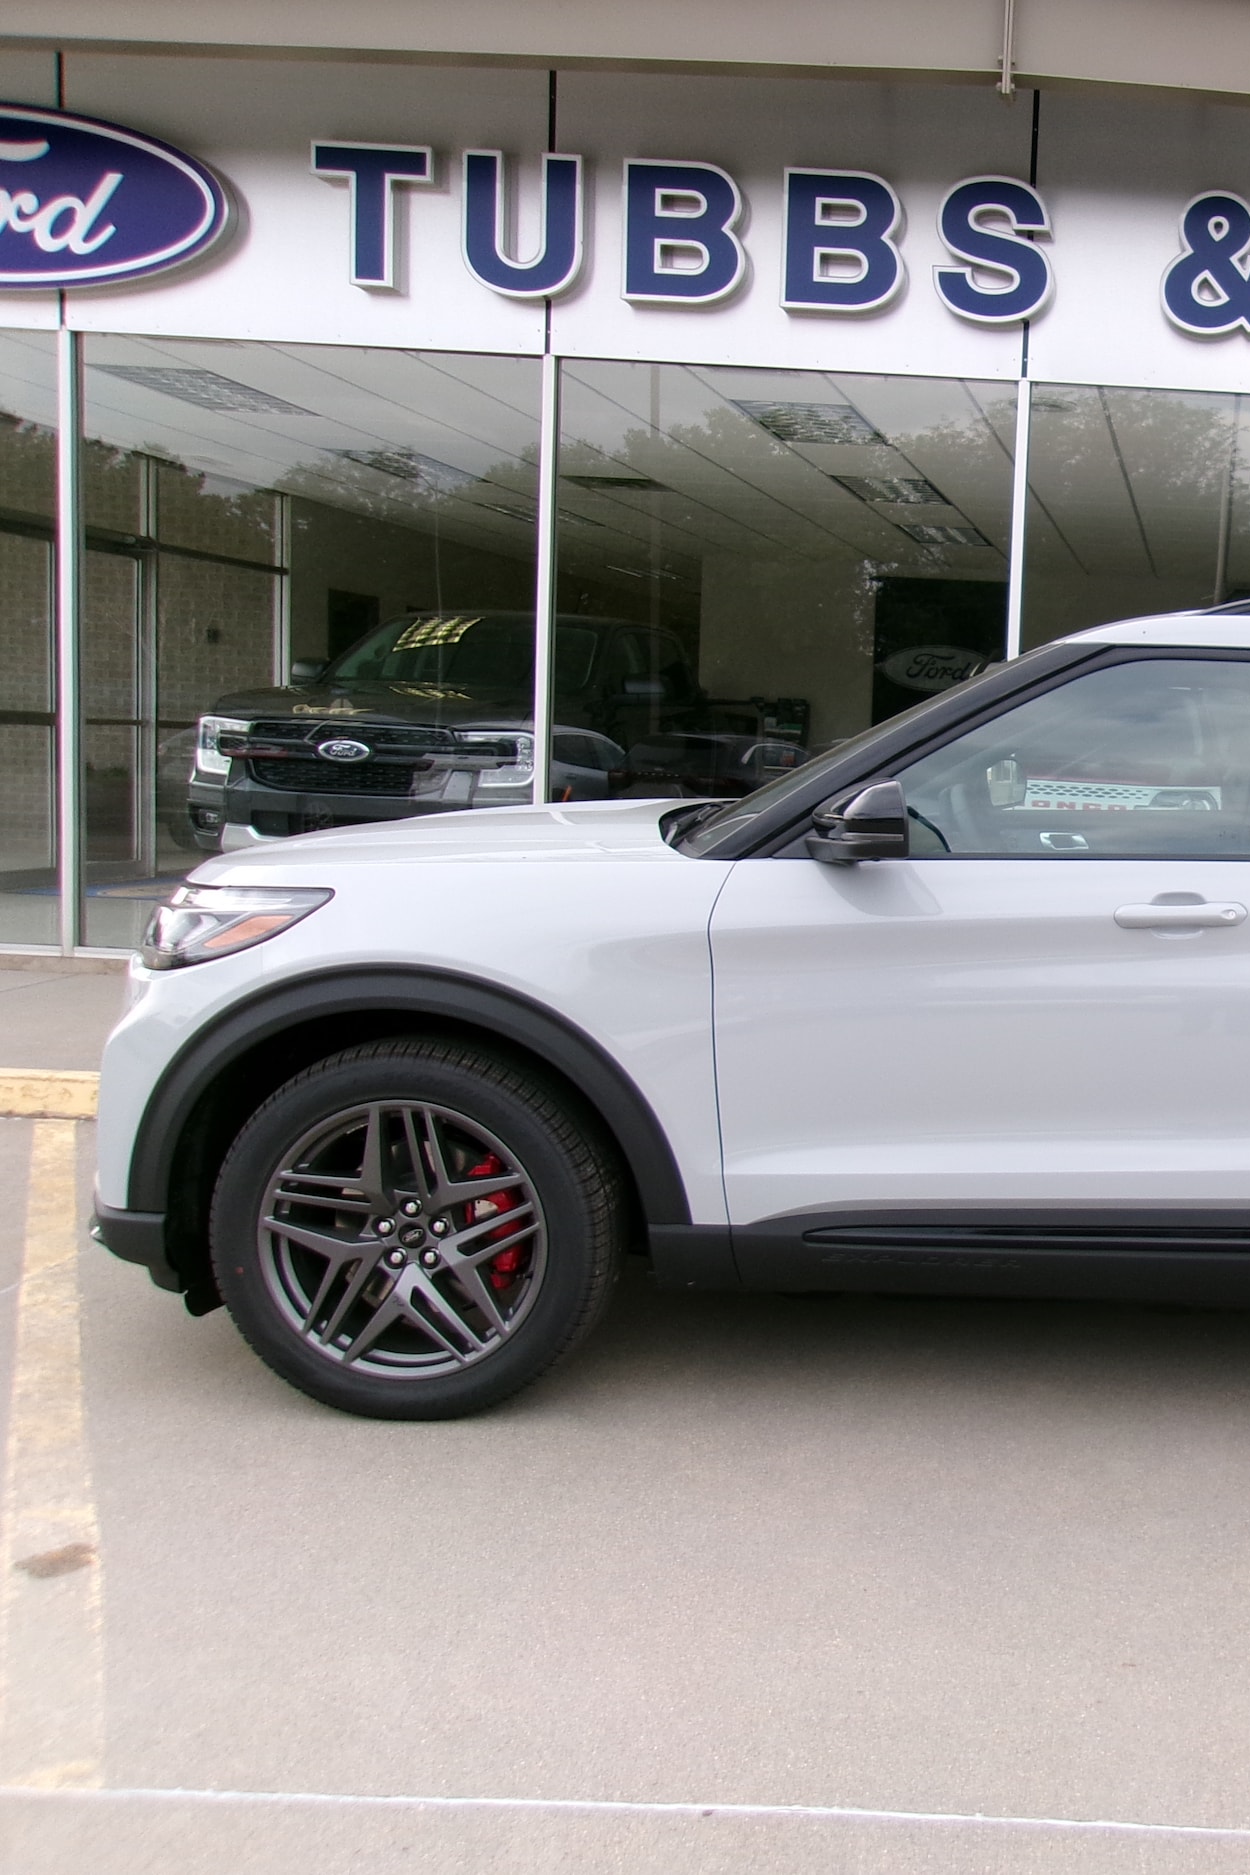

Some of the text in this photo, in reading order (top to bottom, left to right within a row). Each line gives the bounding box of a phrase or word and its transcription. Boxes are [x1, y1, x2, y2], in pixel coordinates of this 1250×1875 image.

[0, 138, 124, 255] rd
[310, 139, 1054, 324] TUBBS
[905, 652, 970, 681] Ford
[329, 743, 358, 757] Ford
